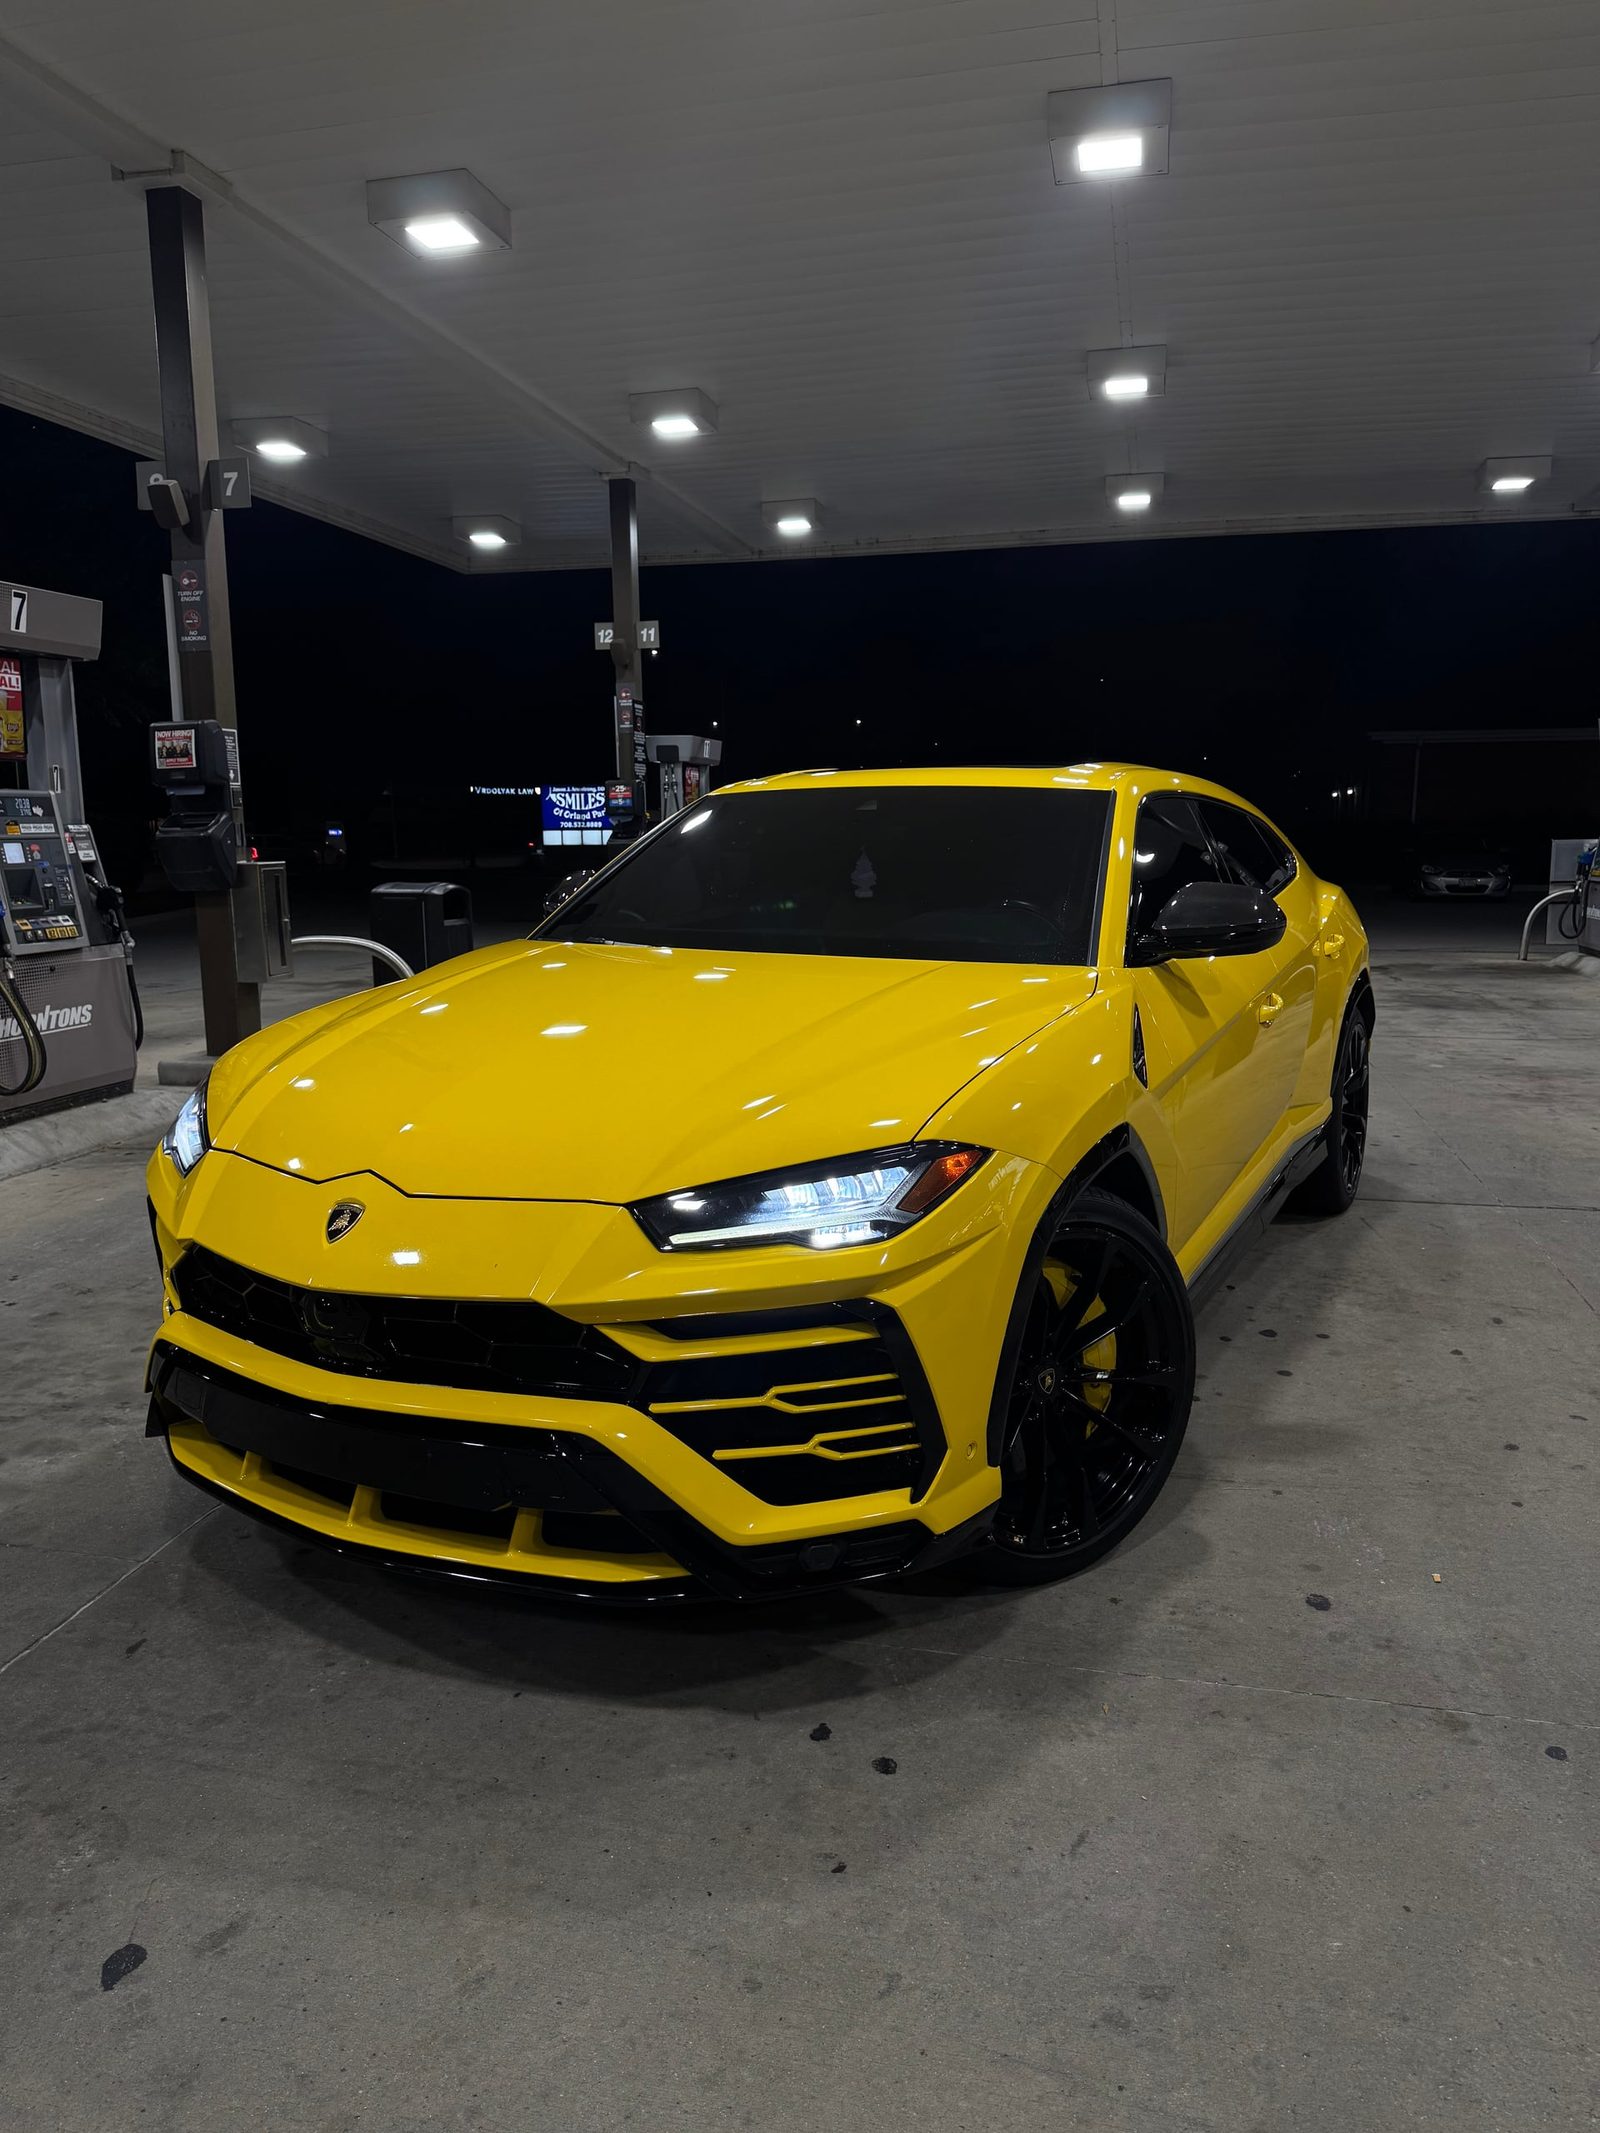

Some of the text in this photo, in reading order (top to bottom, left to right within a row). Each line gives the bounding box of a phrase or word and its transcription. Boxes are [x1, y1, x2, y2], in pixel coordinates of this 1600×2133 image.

[223, 472, 239, 496] 7
[13, 591, 27, 630] 7
[597, 629, 614, 643] 12
[640, 627, 655, 642] 11
[474, 786, 516, 795] VRDOLYAK
[555, 792, 606, 810] SMILES
[553, 807, 564, 817] Of
[591, 807, 606, 819] Par
[0, 1004, 93, 1038] HONTONS
